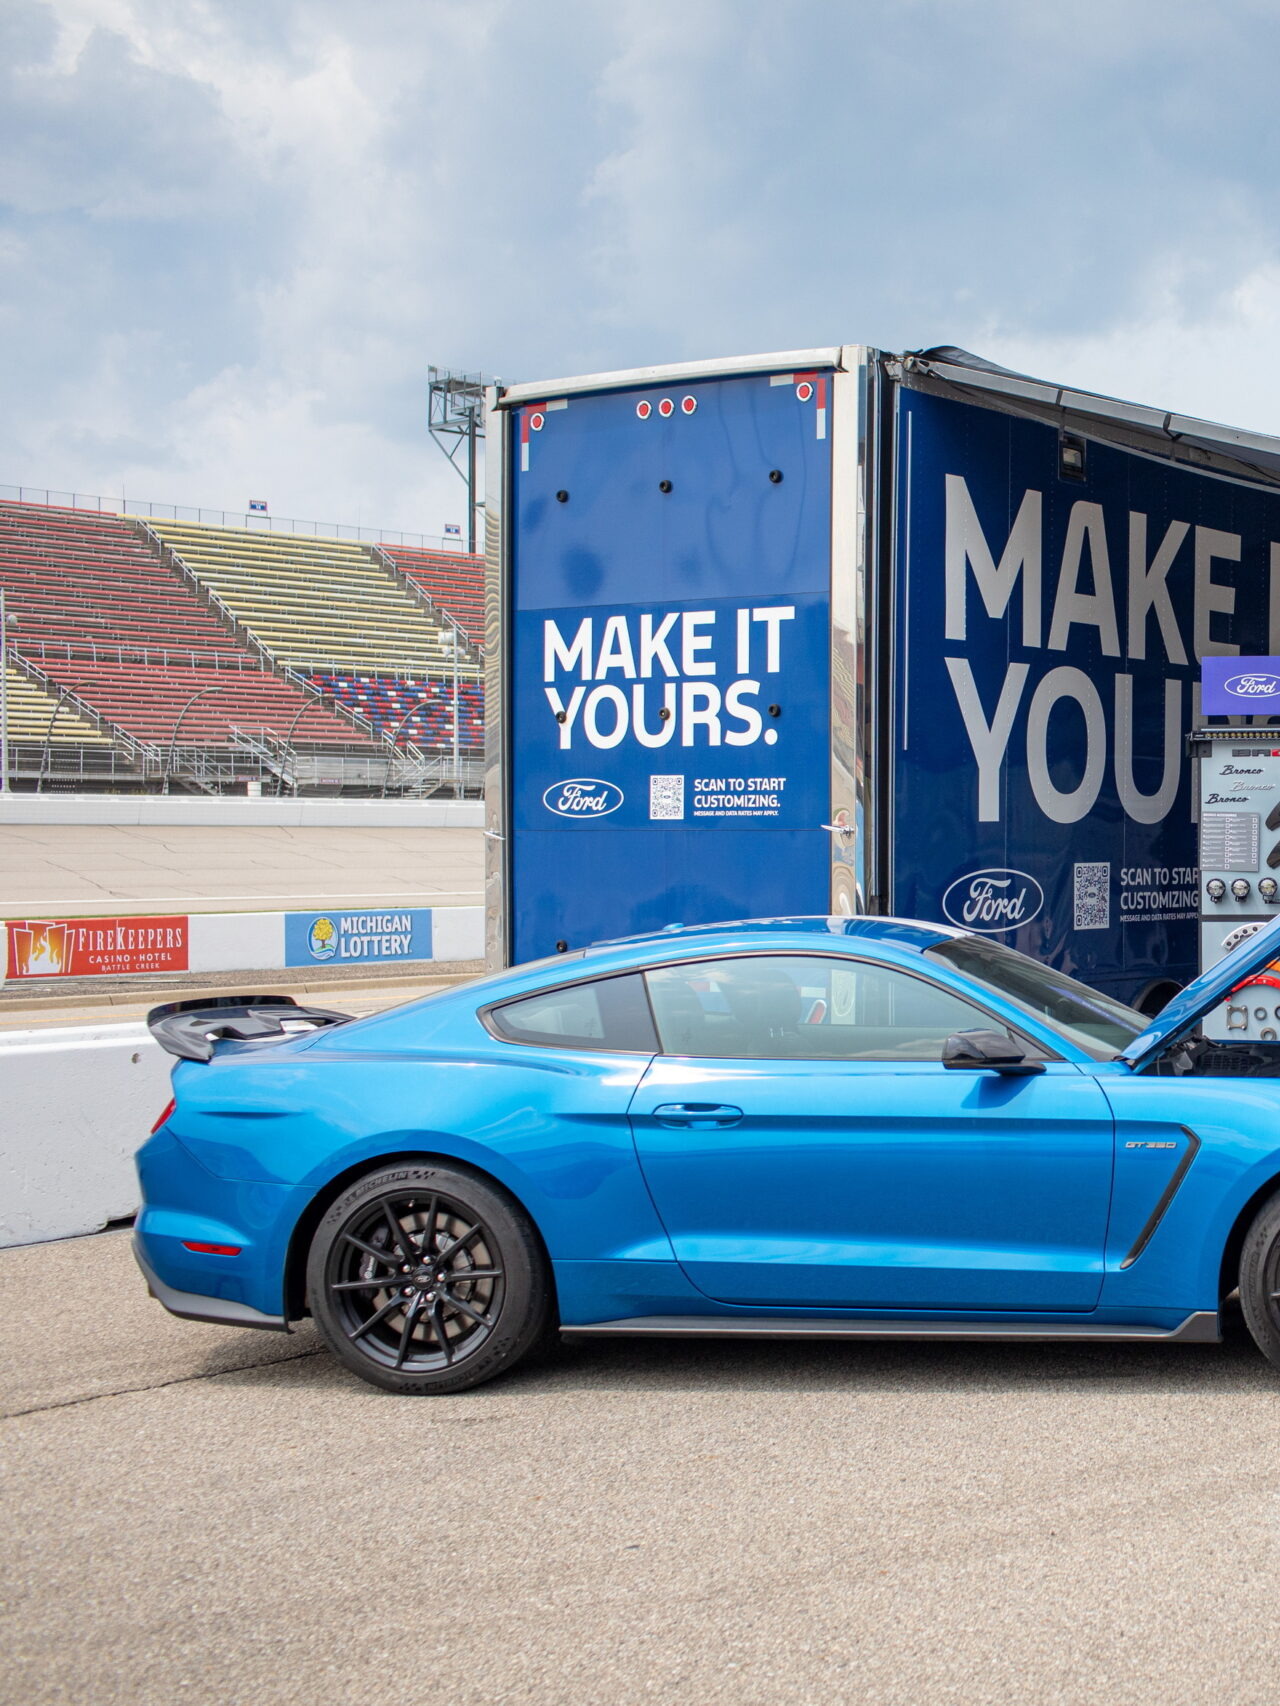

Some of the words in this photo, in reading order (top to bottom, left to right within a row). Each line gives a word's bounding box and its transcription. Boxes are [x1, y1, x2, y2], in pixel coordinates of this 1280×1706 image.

[944, 473, 1243, 665] MAKE
[544, 611, 717, 682] MAKE
[737, 606, 796, 674] IT
[1236, 676, 1277, 694] Ford
[544, 679, 779, 750] YOURS.
[1219, 764, 1264, 776] Bronco
[694, 779, 726, 792] SCAN
[728, 779, 745, 792] TO
[747, 777, 787, 791] START
[1229, 781, 1275, 792] Bronco
[557, 783, 609, 812] Ford
[694, 794, 781, 808] CUSTOMIZING.
[1204, 793, 1250, 804] Bronco
[1121, 868, 1152, 885] SCAN
[1154, 868, 1170, 885] TO
[1172, 867, 1199, 885] STAR
[963, 877, 1027, 922] Ford
[340, 914, 412, 935] MICHIGAN
[88, 953, 131, 964] CASINO
[139, 952, 172, 961] HOTEL
[101, 964, 131, 972] BATTLE
[135, 962, 160, 970] CREEK
